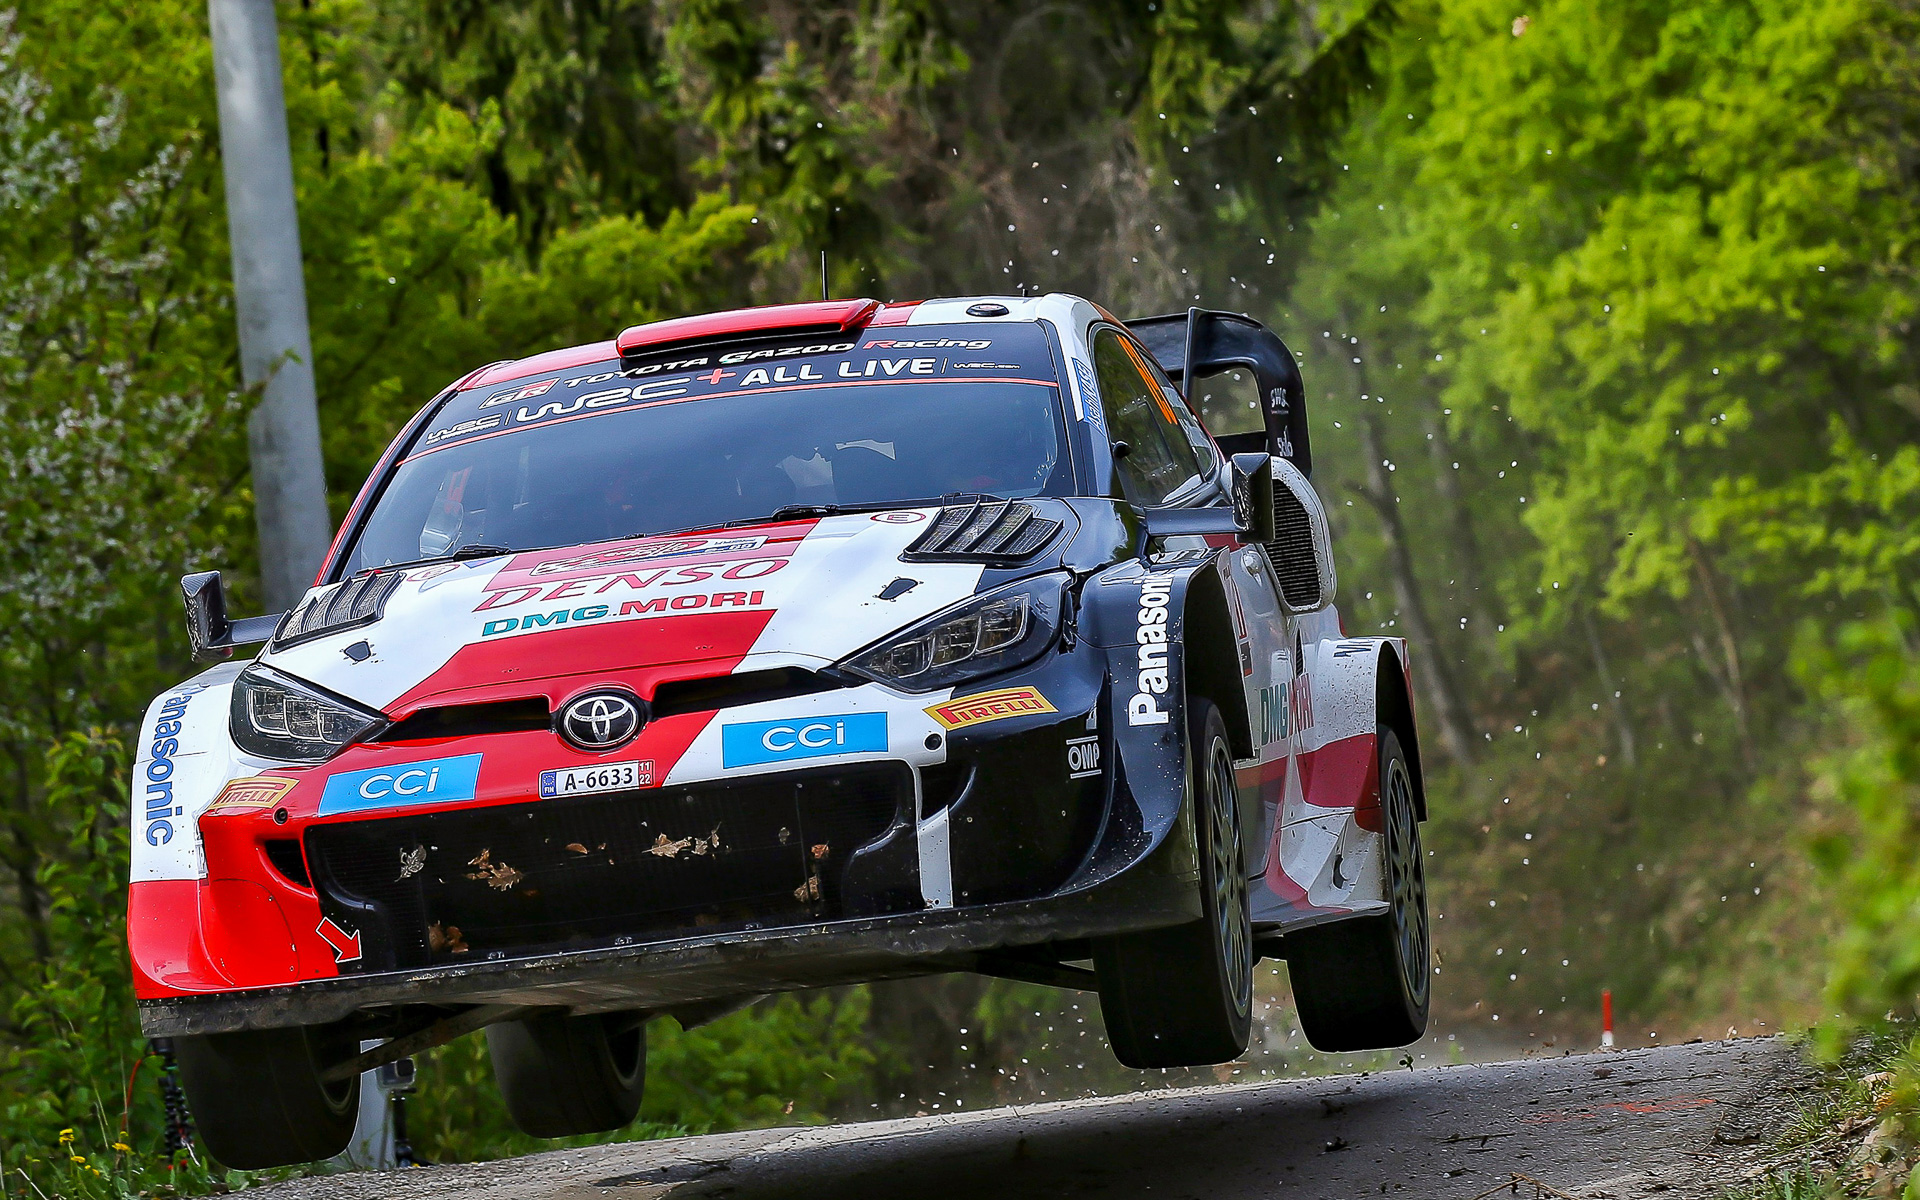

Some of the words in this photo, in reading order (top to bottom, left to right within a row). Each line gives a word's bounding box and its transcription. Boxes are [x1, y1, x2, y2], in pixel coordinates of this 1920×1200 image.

[563, 356, 709, 388] TOYOTA
[718, 342, 856, 364] GAZOO
[862, 338, 993, 350] Racing
[739, 363, 824, 387] ALL
[838, 357, 937, 378] LIVE
[470, 559, 790, 613] DENSO
[481, 603, 610, 638] DMG
[619, 589, 765, 616] MORI
[937, 691, 1045, 725] PIRELLI
[640, 762, 650, 771] 11
[1067, 742, 1100, 771] OMP
[212, 781, 287, 806] PIRELLI
[564, 767, 633, 791] A-6633
[640, 774, 651, 785] 22
